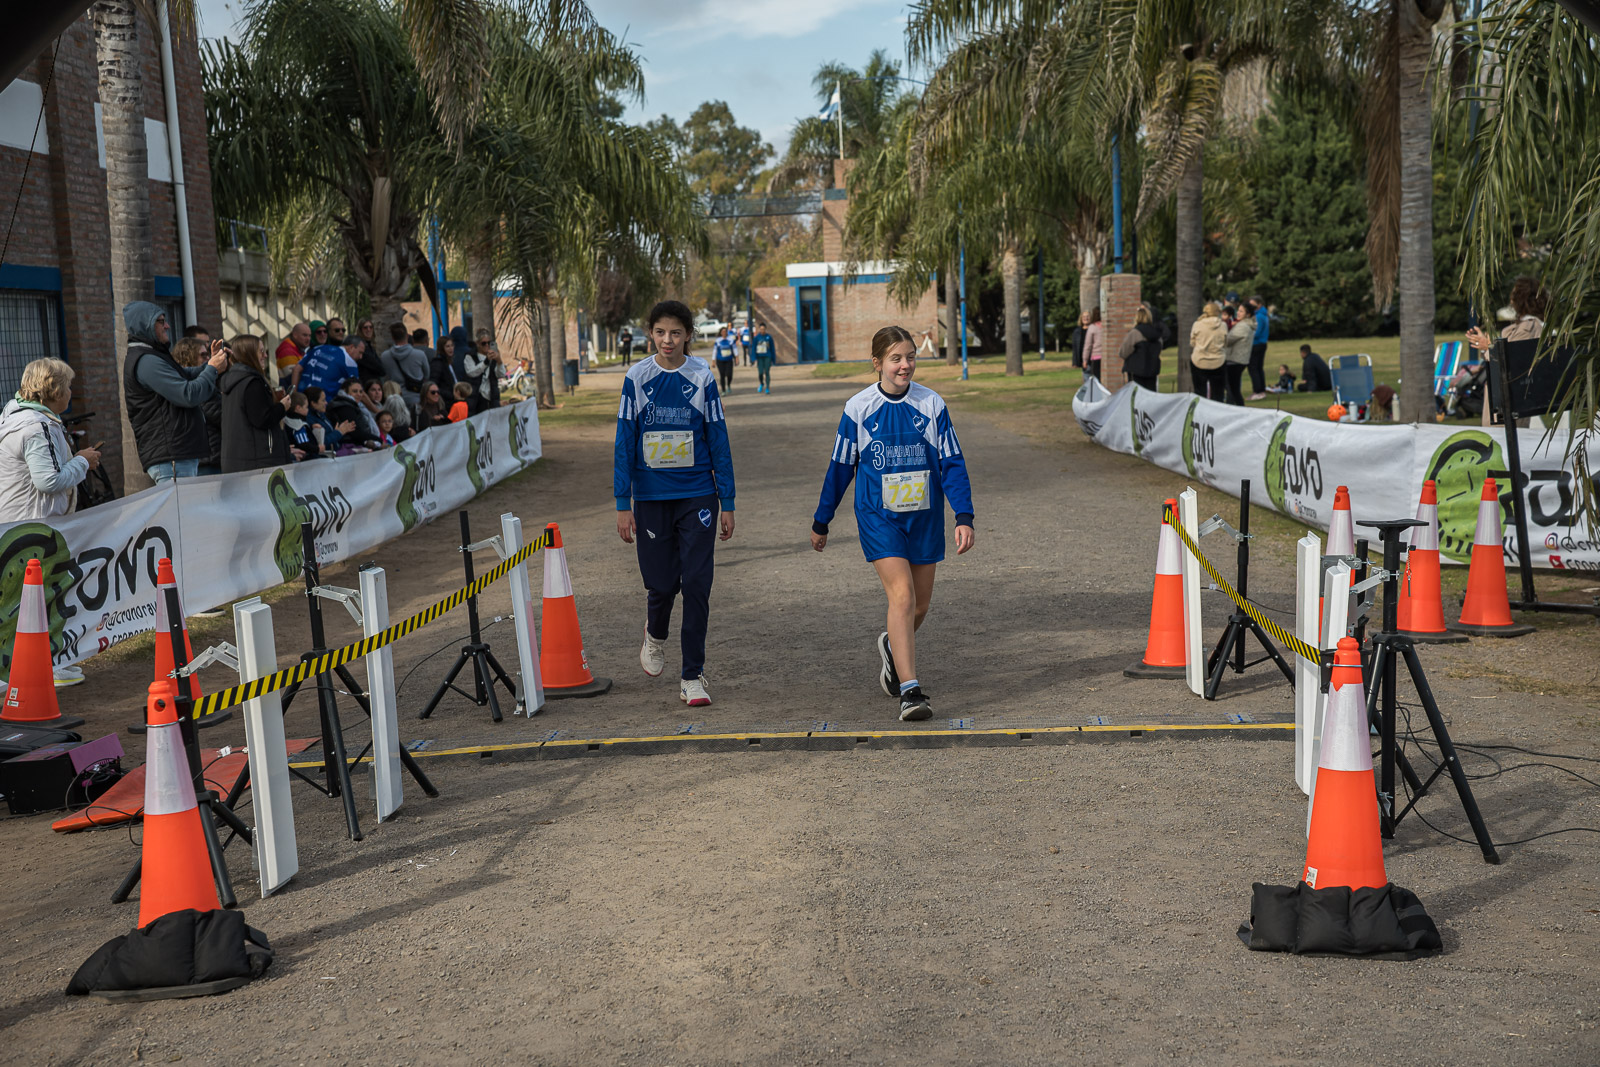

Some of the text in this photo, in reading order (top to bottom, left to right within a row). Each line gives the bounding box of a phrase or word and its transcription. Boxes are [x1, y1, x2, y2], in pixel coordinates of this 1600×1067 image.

[644, 401, 656, 426] 3
[647, 441, 688, 460] 724
[871, 440, 926, 470] 3 MARATÓN
[888, 482, 925, 504] 723
